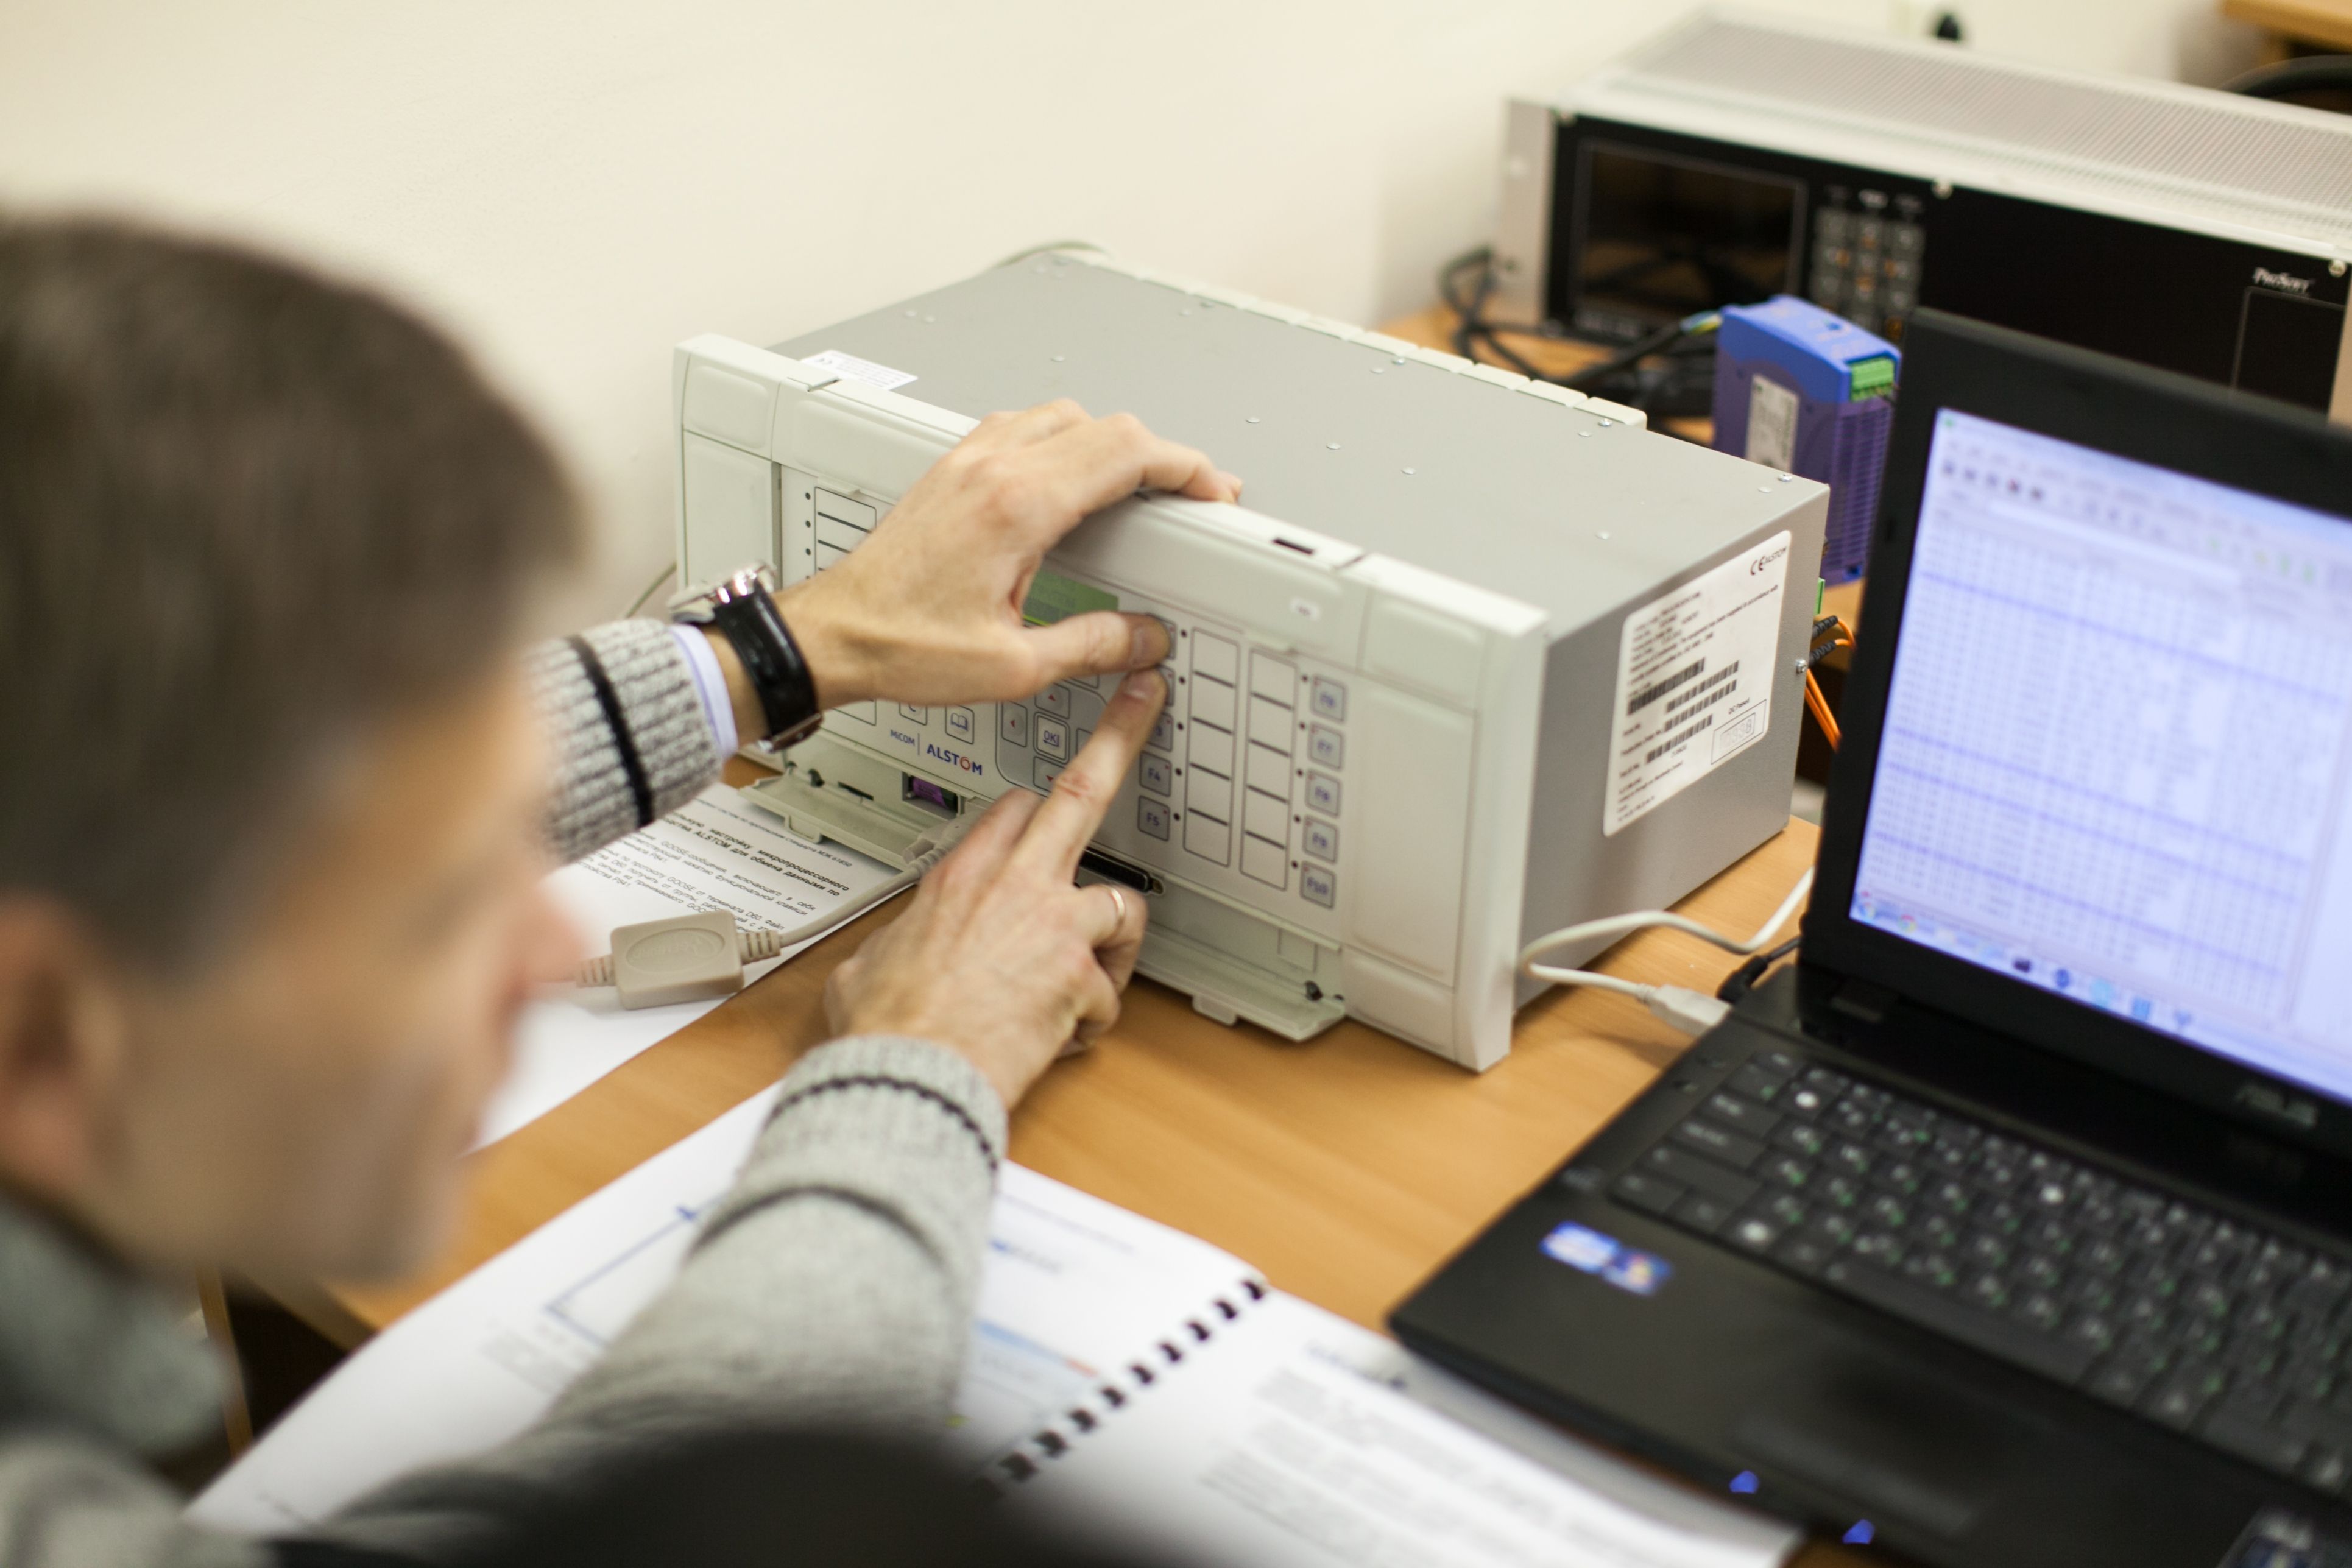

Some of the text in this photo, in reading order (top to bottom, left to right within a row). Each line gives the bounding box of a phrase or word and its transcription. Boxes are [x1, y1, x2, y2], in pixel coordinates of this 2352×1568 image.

[926, 744, 983, 776] ALSTOM
[1148, 768, 1161, 782] F4
[1147, 813, 1160, 827] F5
[694, 831, 730, 847] ALSTOM
[730, 848, 748, 856] для
[750, 856, 783, 871] обмена
[784, 871, 824, 890] данными
[709, 828, 752, 849] настройку
[757, 850, 850, 892] микропроцессорного
[667, 877, 697, 891] GOOSE
[707, 895, 744, 913] терминала
[716, 875, 772, 901] функциональной
[776, 901, 807, 916] клавиши
